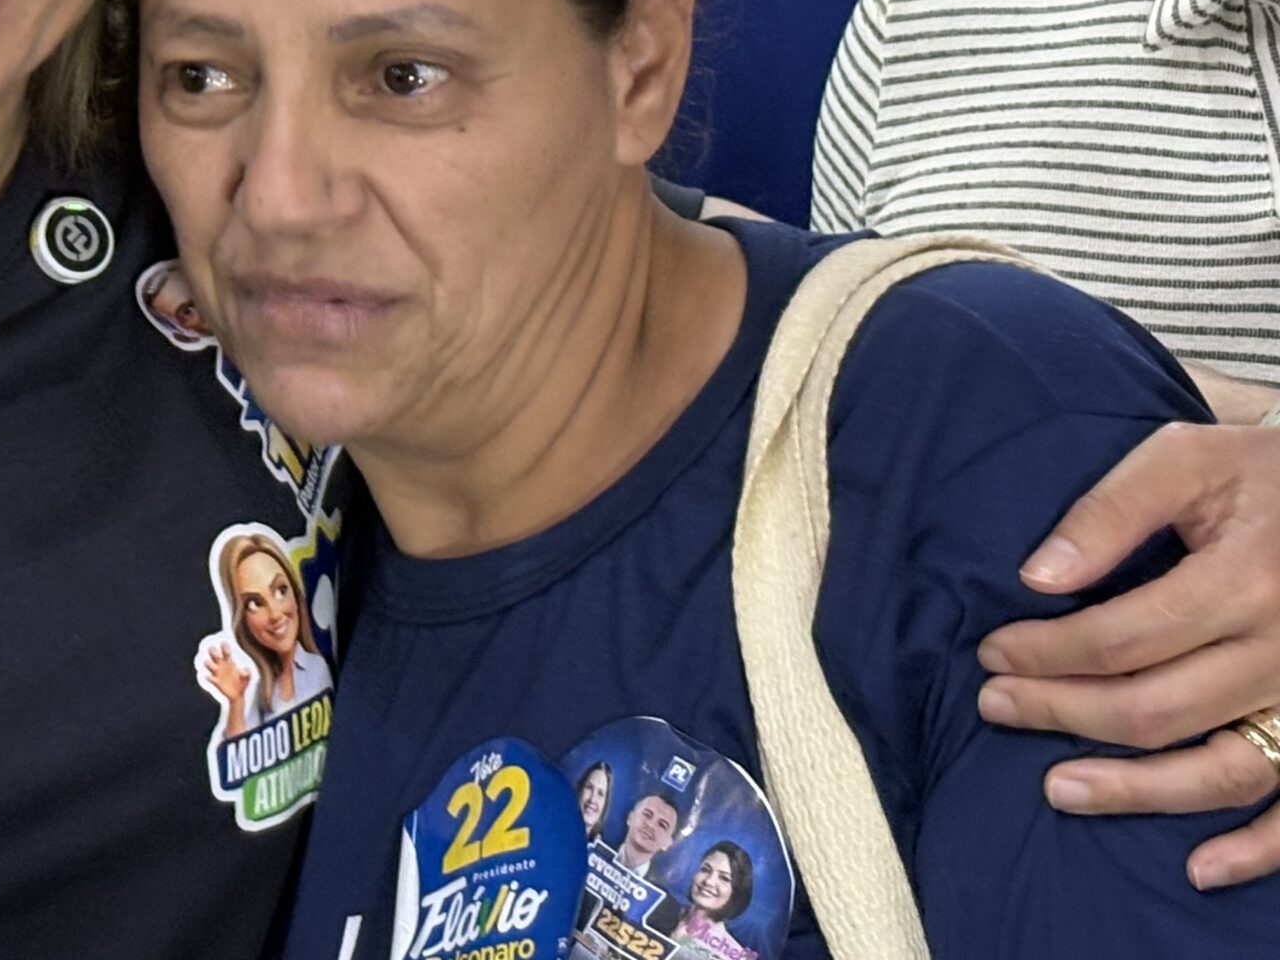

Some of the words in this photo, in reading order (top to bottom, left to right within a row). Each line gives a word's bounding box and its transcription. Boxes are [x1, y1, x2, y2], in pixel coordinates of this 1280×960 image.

[227, 719, 290, 782] MODO
[668, 763, 687, 784] PL
[442, 764, 531, 875] 22
[472, 858, 536, 883] Presidente
[587, 851, 648, 902] evandro
[410, 876, 549, 959] Flávio
